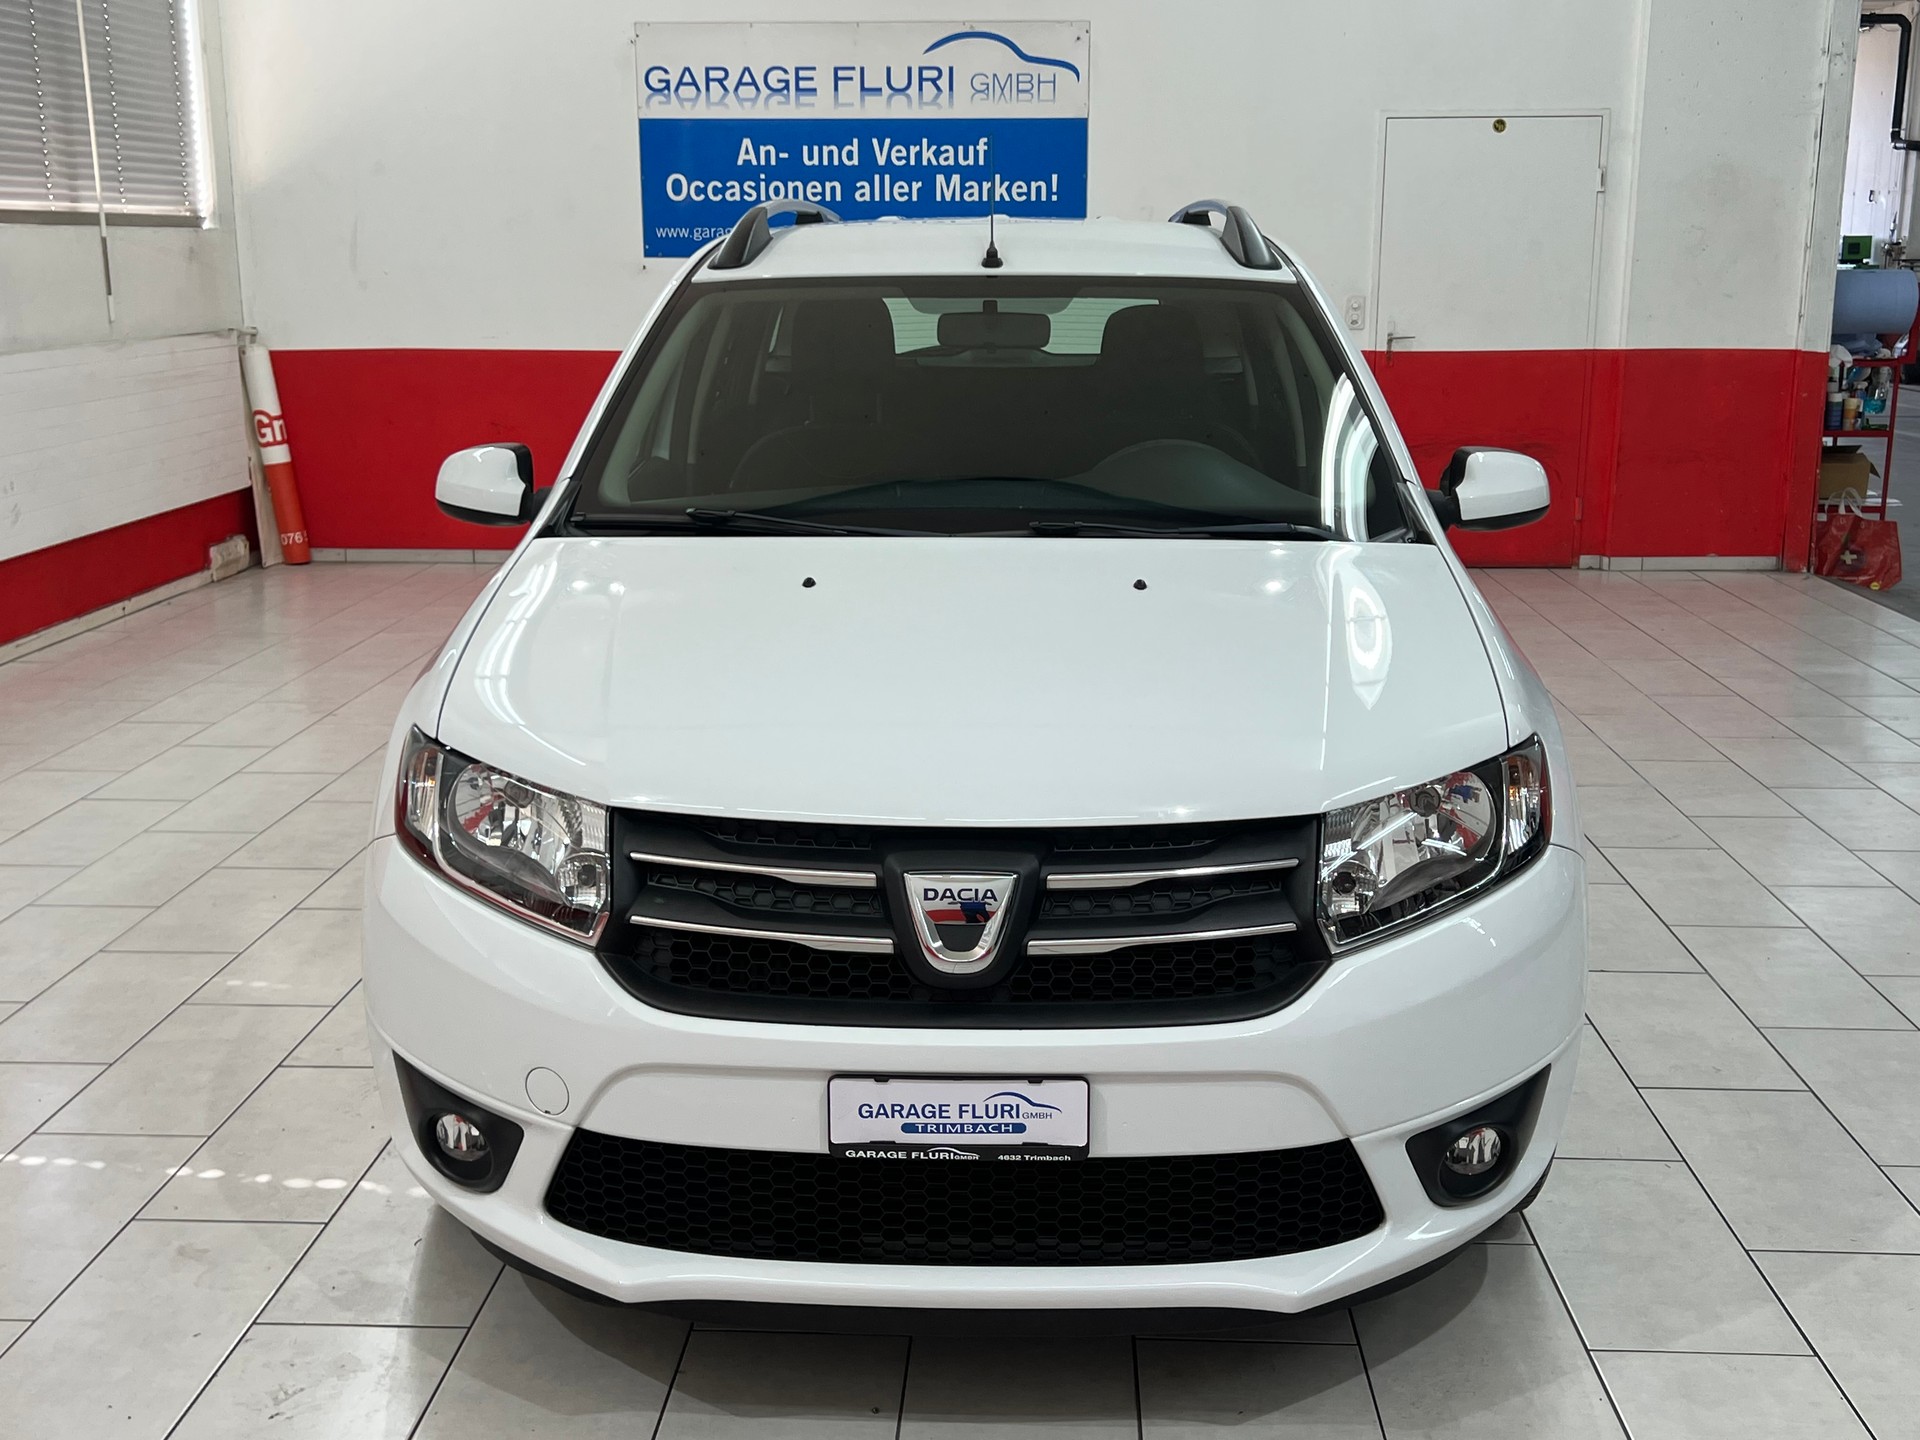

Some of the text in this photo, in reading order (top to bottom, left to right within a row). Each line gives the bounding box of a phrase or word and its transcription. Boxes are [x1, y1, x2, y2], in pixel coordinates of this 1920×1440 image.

[643, 66, 1056, 96] GARAGE FLURI GMBH
[737, 138, 988, 166] An- und Verkauf
[665, 173, 1058, 202] Occasionen aller Marken!
[923, 888, 998, 902] DACIA
[858, 1103, 1053, 1120] GARAGE FLURI GMBH
[915, 1123, 1013, 1133] TRIMBACH
[845, 1149, 907, 1159] GARAGE
[911, 1151, 954, 1160] FLURI
[1023, 1154, 1071, 1162] Trimbach
